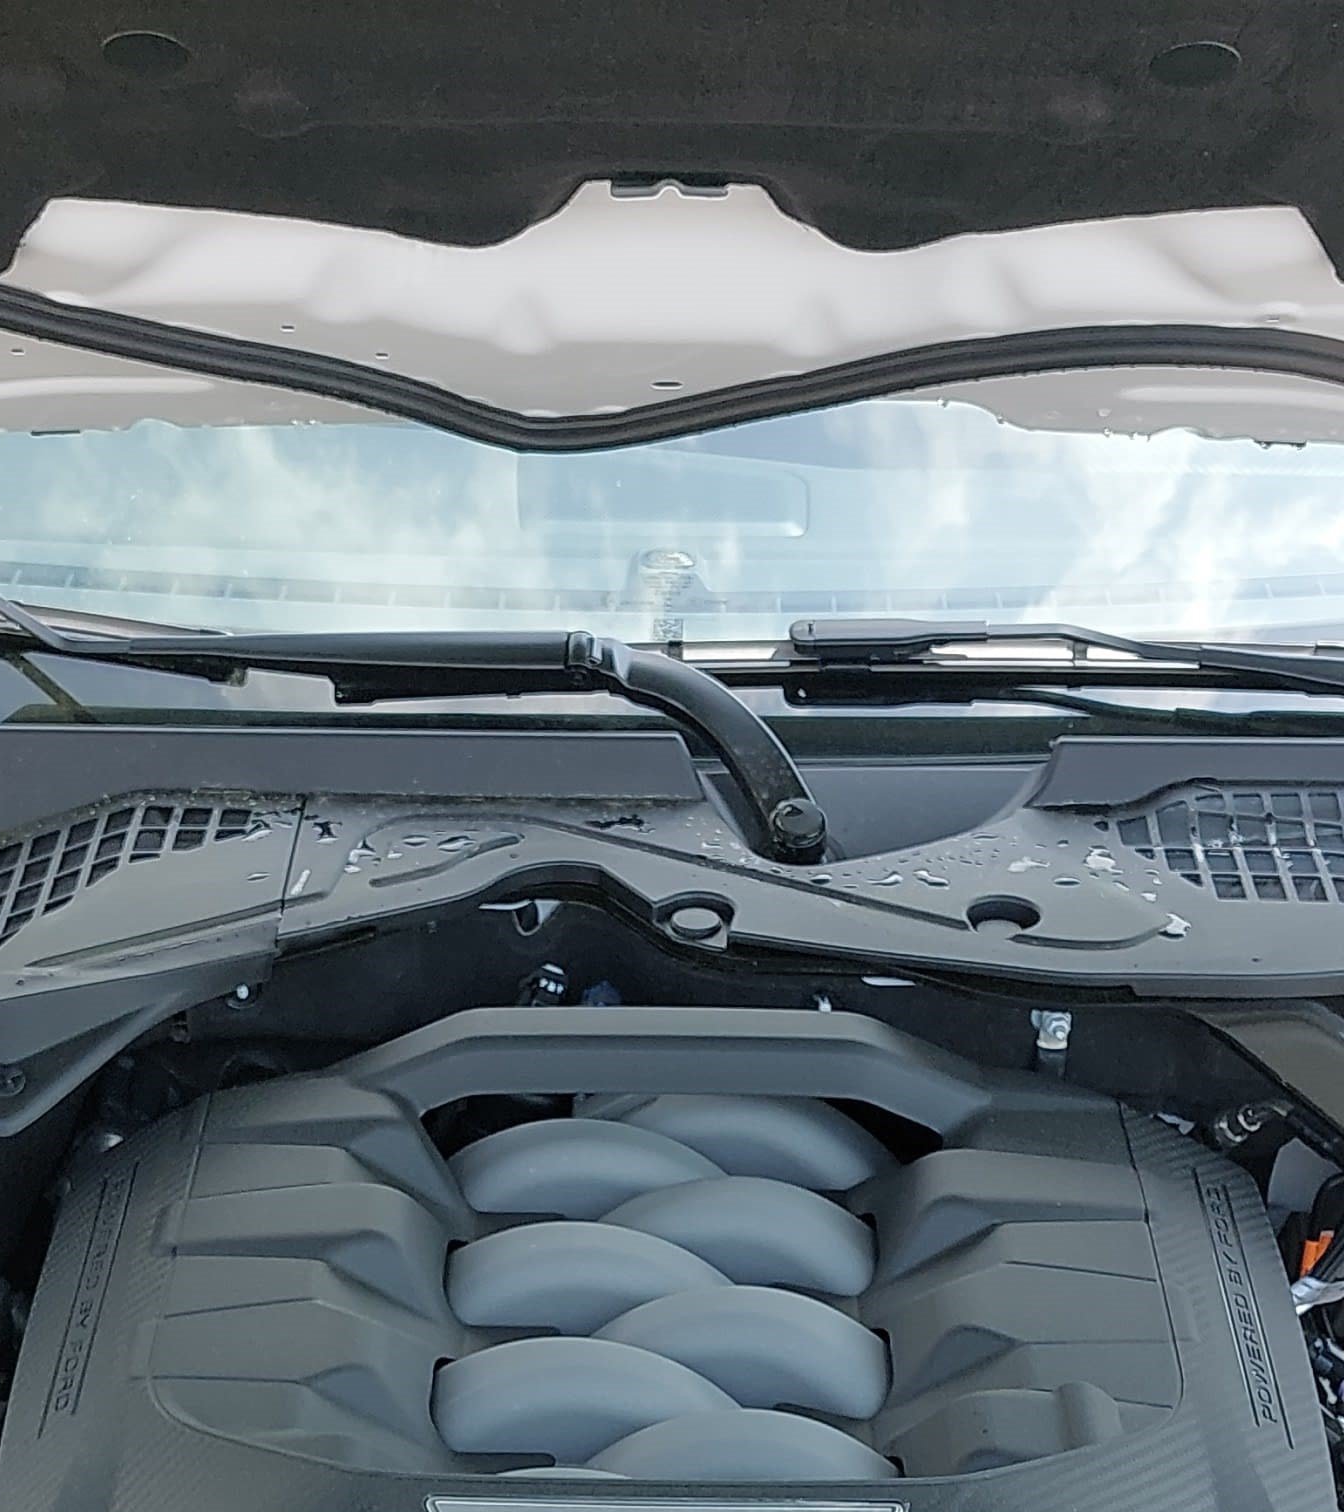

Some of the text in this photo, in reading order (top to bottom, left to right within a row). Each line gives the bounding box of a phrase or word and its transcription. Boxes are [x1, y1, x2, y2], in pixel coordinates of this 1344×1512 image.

[54, 1340, 83, 1412] FORD
[1207, 1184, 1278, 1424] POWERED BY FORD
